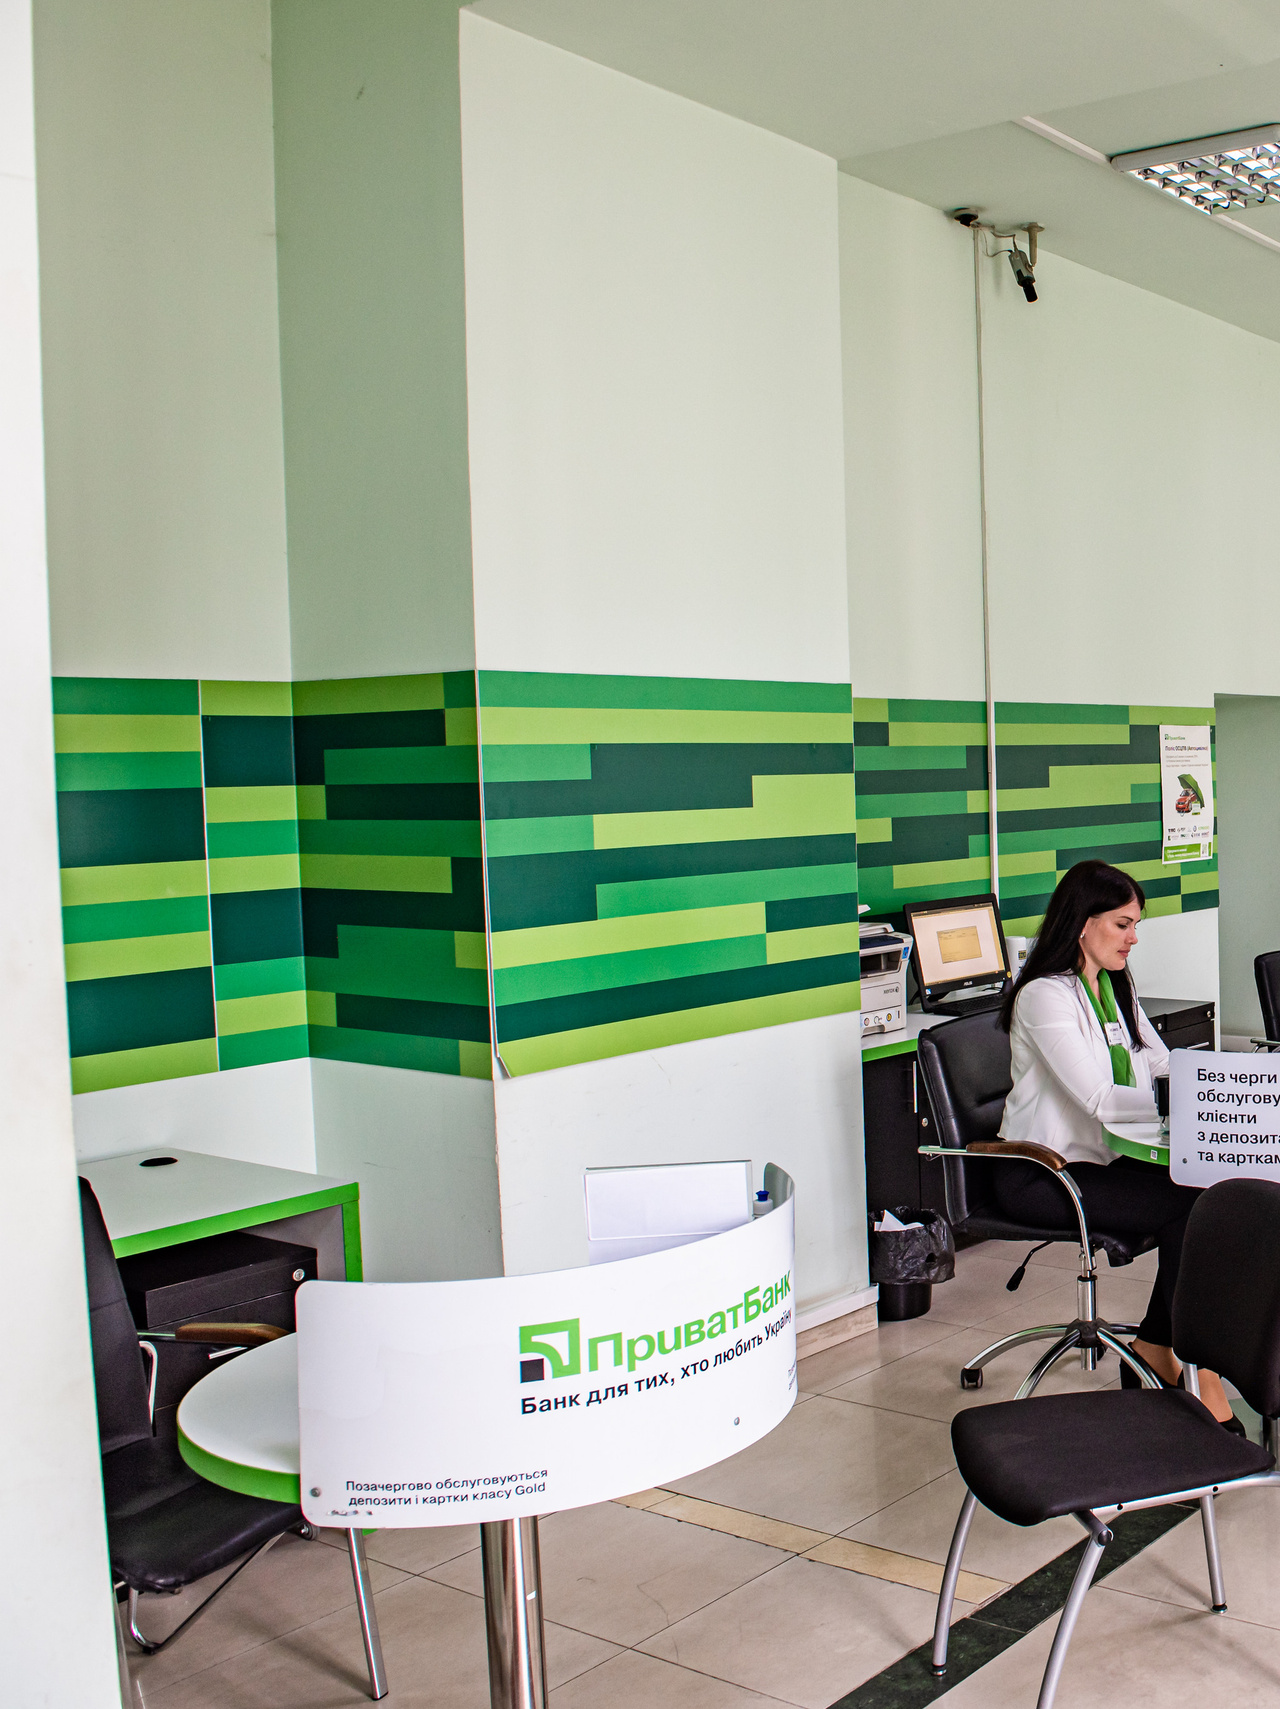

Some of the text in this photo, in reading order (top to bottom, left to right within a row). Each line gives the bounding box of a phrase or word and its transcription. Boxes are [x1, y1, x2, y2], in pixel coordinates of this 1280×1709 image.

[1197, 1068, 1278, 1086] Без черги
[1197, 1110, 1257, 1124] клієнти
[1197, 1131, 1206, 1141] з
[1197, 1151, 1214, 1162] та
[588, 1269, 791, 1373] ПриватБанк
[520, 1393, 581, 1415] Банк
[586, 1383, 629, 1406] для
[634, 1372, 675, 1392] тих,
[681, 1356, 709, 1379] хто
[712, 1335, 763, 1367] любить
[346, 1469, 548, 1493] Позачергово обслуговуються
[348, 1495, 411, 1506] депозити
[422, 1493, 468, 1506] картки
[472, 1488, 512, 1501] класу
[515, 1482, 546, 1496] Gold
